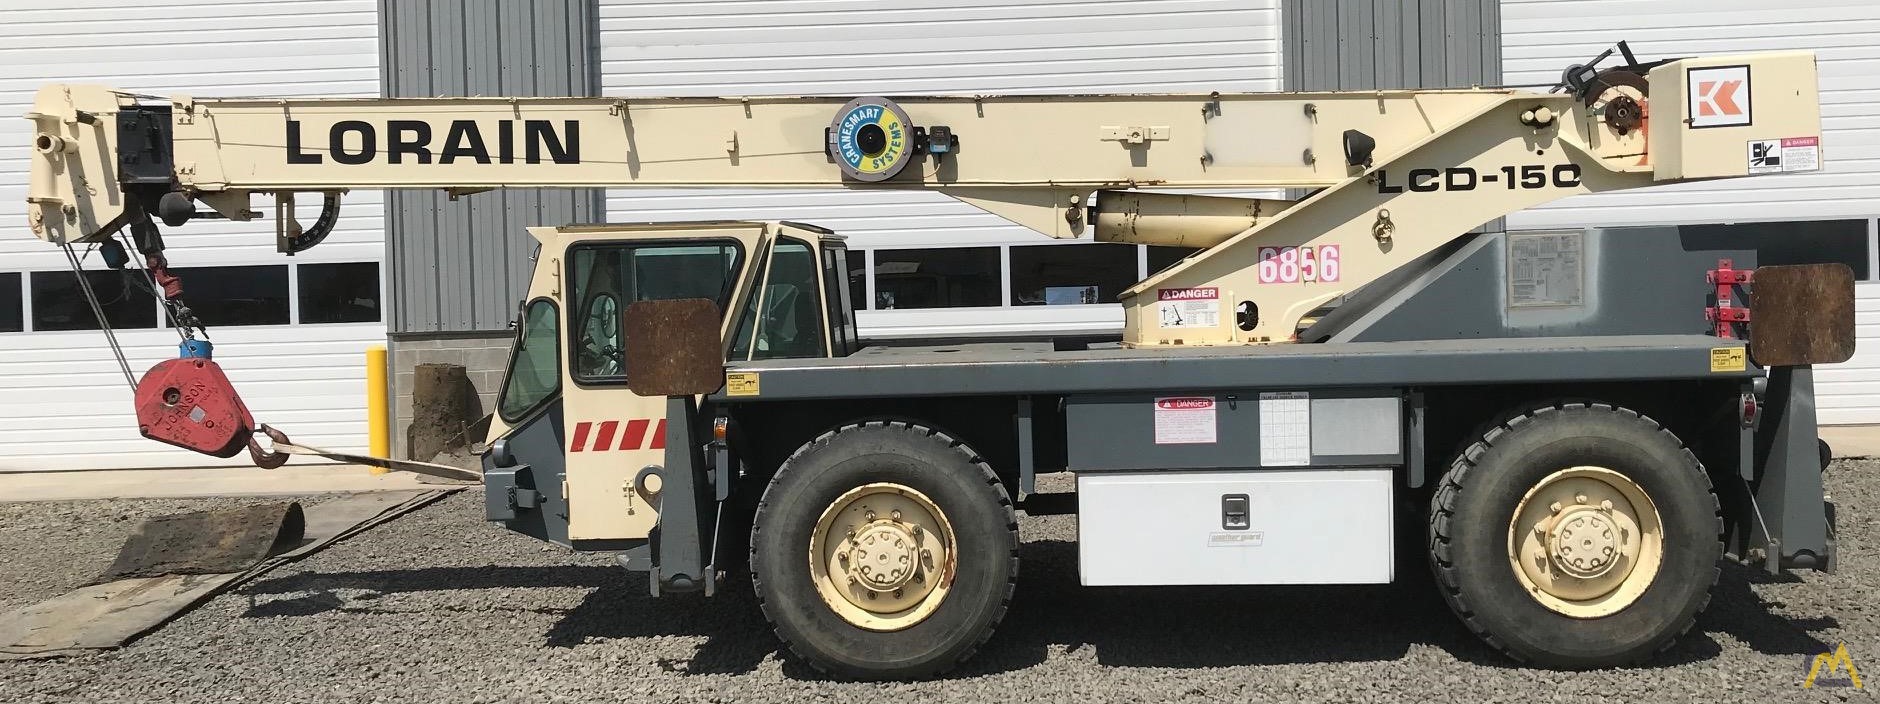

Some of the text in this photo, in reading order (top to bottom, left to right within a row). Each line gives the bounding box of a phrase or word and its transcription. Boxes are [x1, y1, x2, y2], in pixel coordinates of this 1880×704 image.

[286, 119, 581, 165] LORAIN
[841, 108, 879, 164] CRANESMART
[872, 121, 902, 170] SYSTEMS
[1377, 163, 1582, 194] LCD-150
[1259, 246, 1339, 283] 6856
[1171, 288, 1217, 299] DANGER
[164, 381, 206, 432] JOHNSON
[1176, 399, 1209, 408] DANGER
